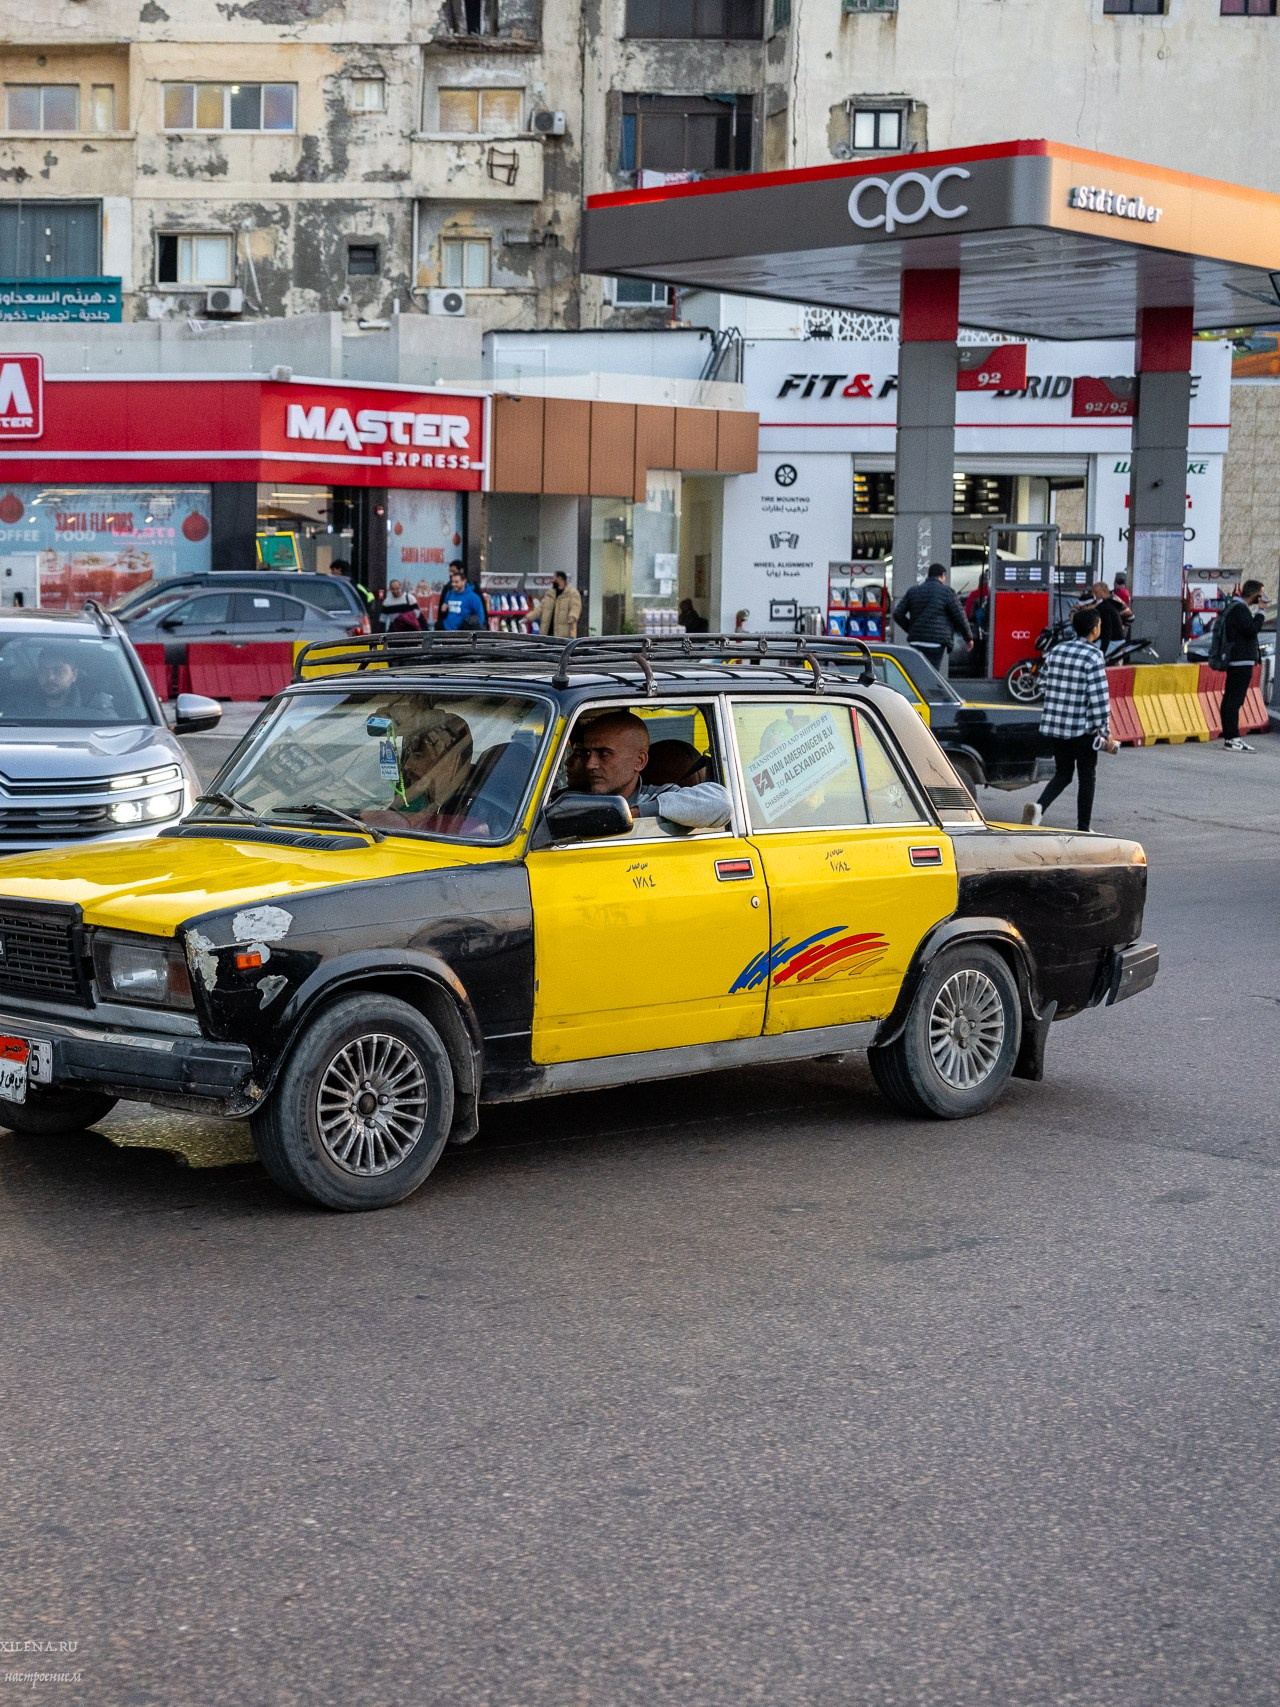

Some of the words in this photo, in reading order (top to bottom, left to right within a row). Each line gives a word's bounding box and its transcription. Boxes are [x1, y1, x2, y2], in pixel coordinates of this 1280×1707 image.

[1071, 185, 1112, 213] Sidi
[1115, 194, 1163, 223] Gaber
[978, 372, 1001, 387] 92
[1085, 402, 1128, 413] 92/95
[287, 404, 470, 450] MASTER
[382, 451, 470, 469] EXPRESS
[55, 530, 96, 542] FOOD
[748, 742, 787, 772] TRANSPORTED
[800, 721, 821, 738] SHIPPED
[769, 760, 784, 775] VAN
[783, 733, 823, 767] AMERONGEN
[632, 875, 656, 888] ١٧٨٤
